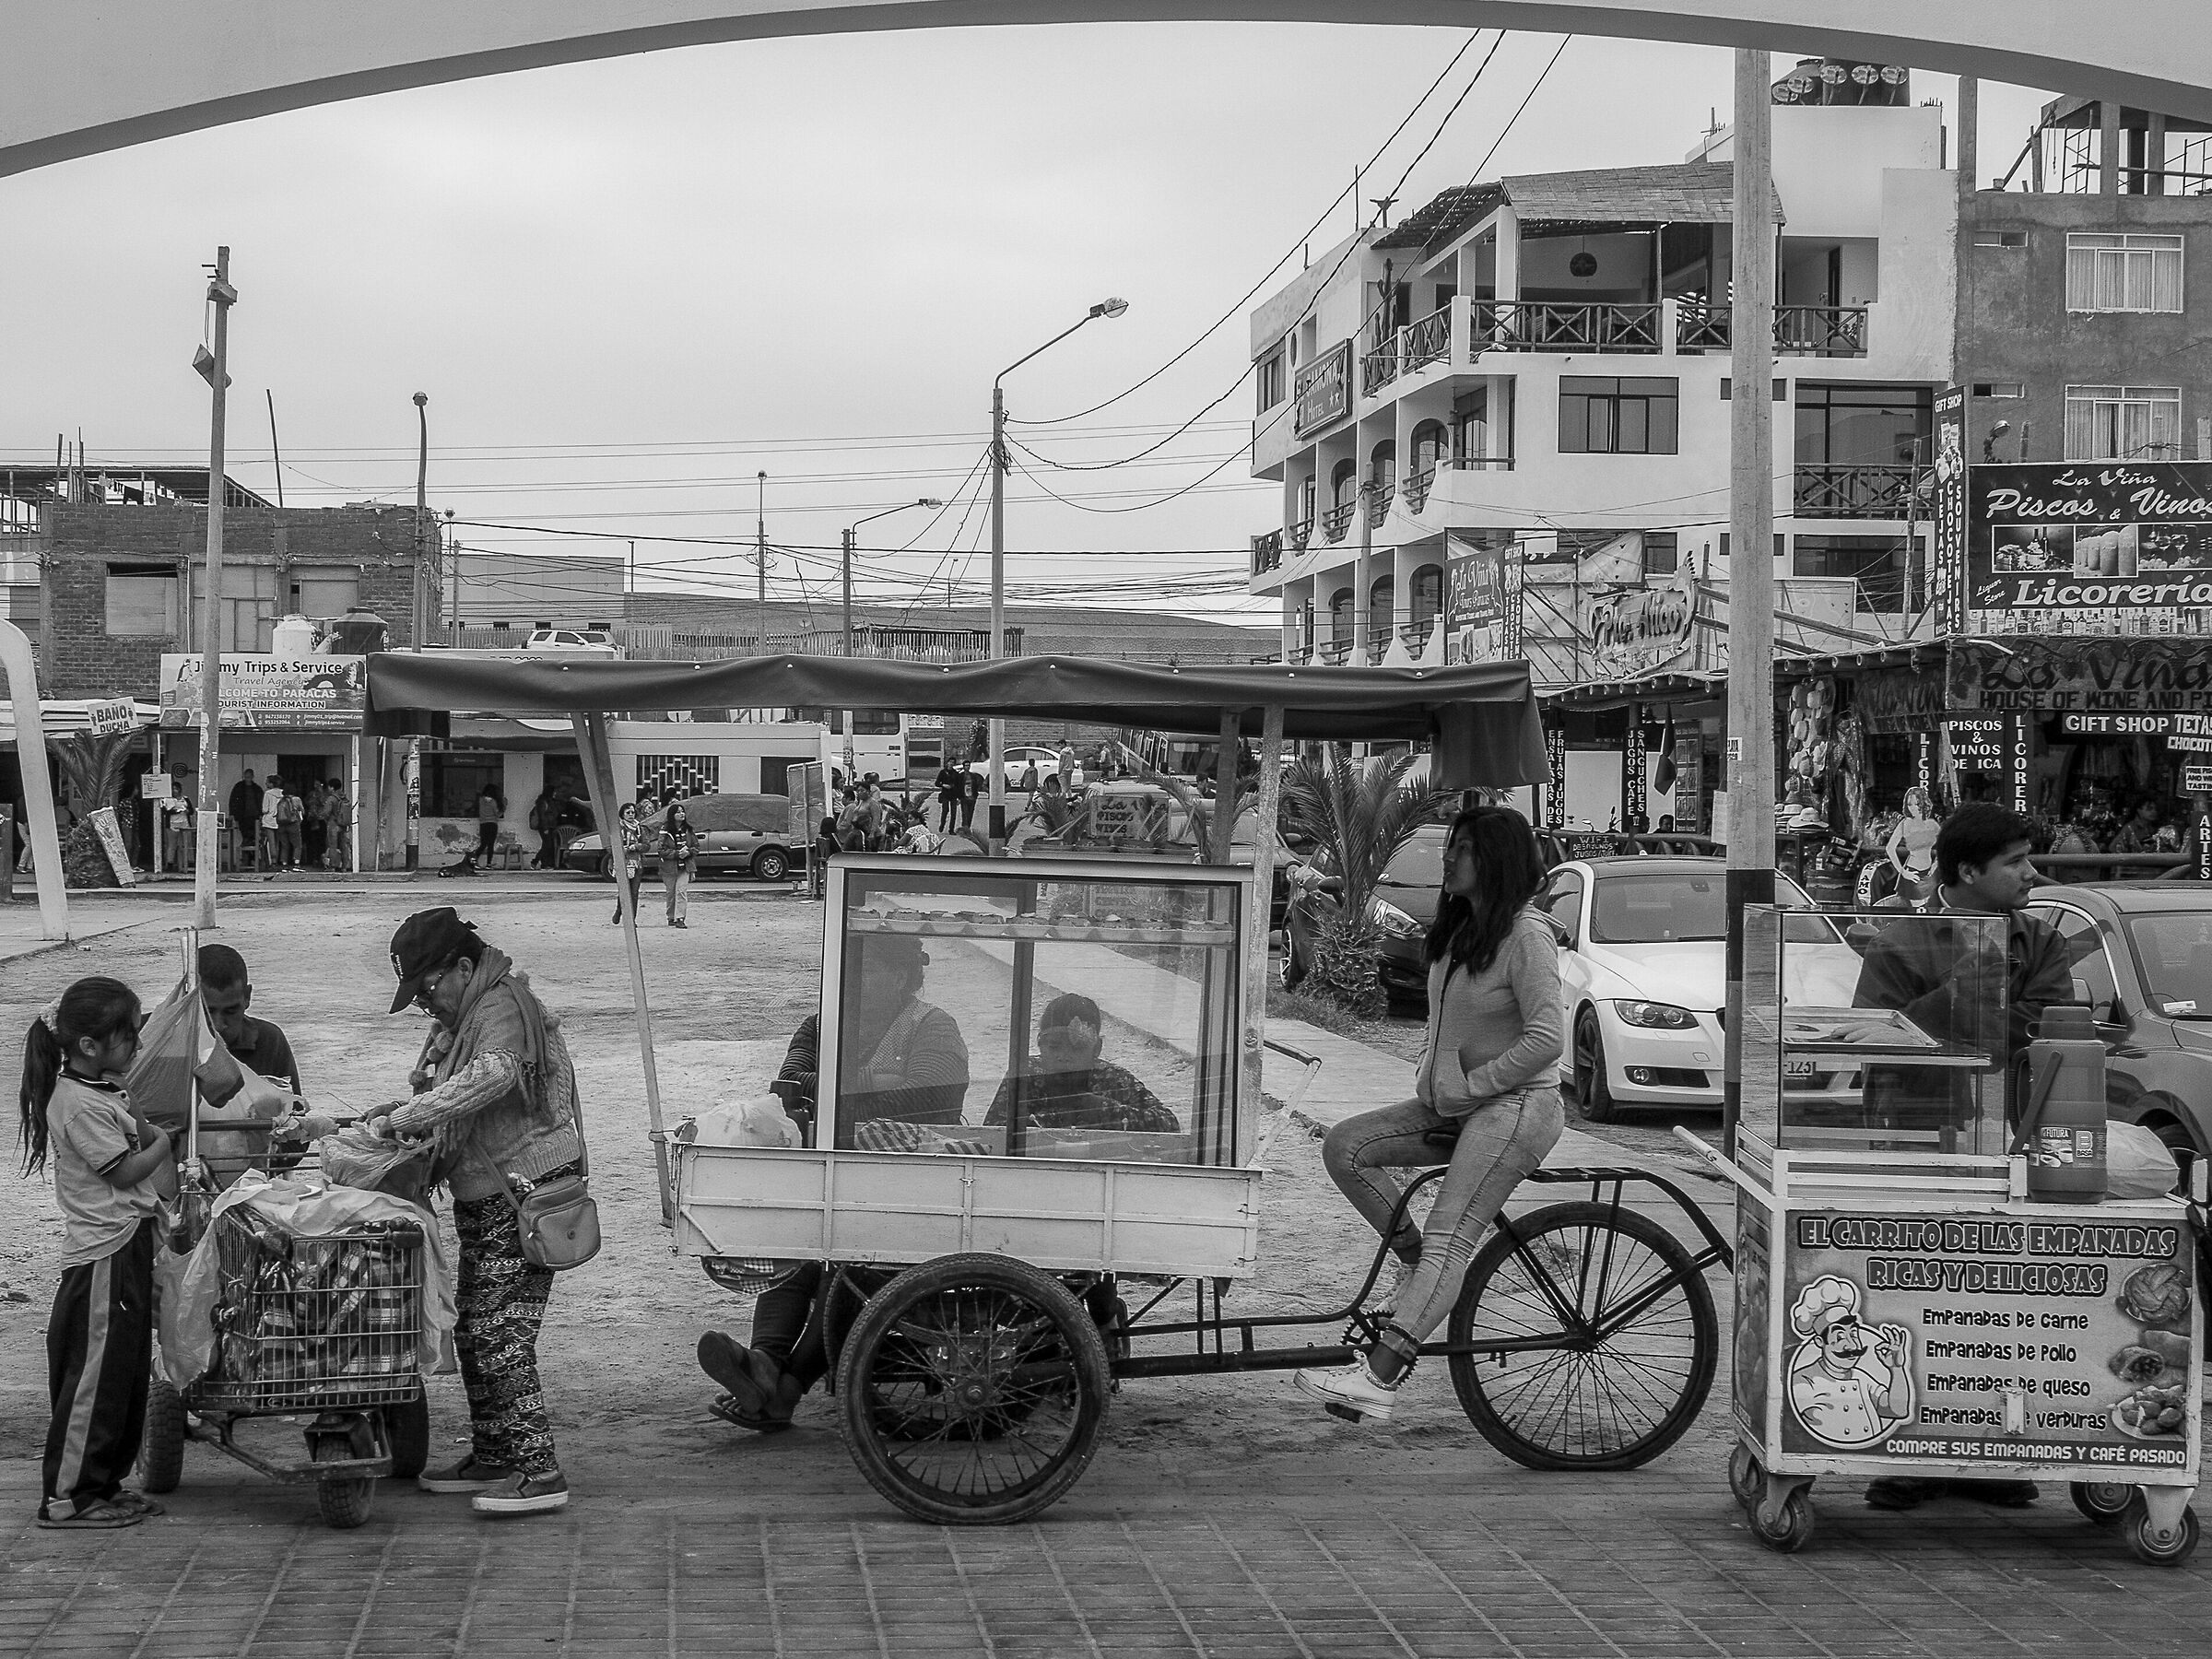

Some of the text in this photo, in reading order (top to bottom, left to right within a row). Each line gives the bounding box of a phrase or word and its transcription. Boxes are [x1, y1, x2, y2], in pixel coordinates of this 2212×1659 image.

[1936, 394, 1961, 413] GIFT SHOP
[2052, 467, 2158, 487] La Viña
[1986, 488, 2098, 519] Piscos
[2109, 508, 2120, 520] &
[1976, 579, 2003, 597] Liquor
[2011, 575, 2212, 606] Licorería
[1984, 590, 2006, 606] Store
[194, 661, 343, 676] Jimy Trips & Service
[1982, 653, 2061, 690] La
[233, 677, 305, 689] Travel Agency
[219, 688, 336, 699] LCOME TO PARACAS
[1982, 691, 2045, 709] HOUSE
[2053, 692, 2075, 709] OF
[2086, 692, 2138, 709] WINE
[2145, 692, 2186, 709] AND
[96, 703, 127, 723] BAÑO
[257, 700, 325, 709] INFORMATION
[100, 721, 130, 733] DUCHA
[1948, 720, 2003, 732] PISCOS
[2065, 715, 2169, 734] GIFT SHOP
[1972, 732, 1983, 743] &
[1556, 730, 1564, 779] FRUTAS
[1627, 730, 1636, 775] JUGOS
[1951, 744, 2002, 756] VINOS
[1637, 730, 1645, 812] SANGUCHES
[1977, 759, 2002, 770] ICA
[1555, 783, 1564, 824] JUGOS
[1627, 781, 1636, 816] CAFE
[1547, 806, 1555, 823] DE
[1579, 835, 1609, 843] WIFI
[2199, 815, 2211, 879] ARTES
[1800, 1219, 2176, 1257] EL CARRITO DE LAS EMPANADAS
[1868, 1259, 2106, 1293] RICAS Y DELICIOSAS
[2042, 1379, 2091, 1399] queso
[2036, 1410, 2107, 1430] verduras
[1886, 1439, 2186, 1465] COMPRE SUS EMPANADAS Y CAFÉ PASADO
